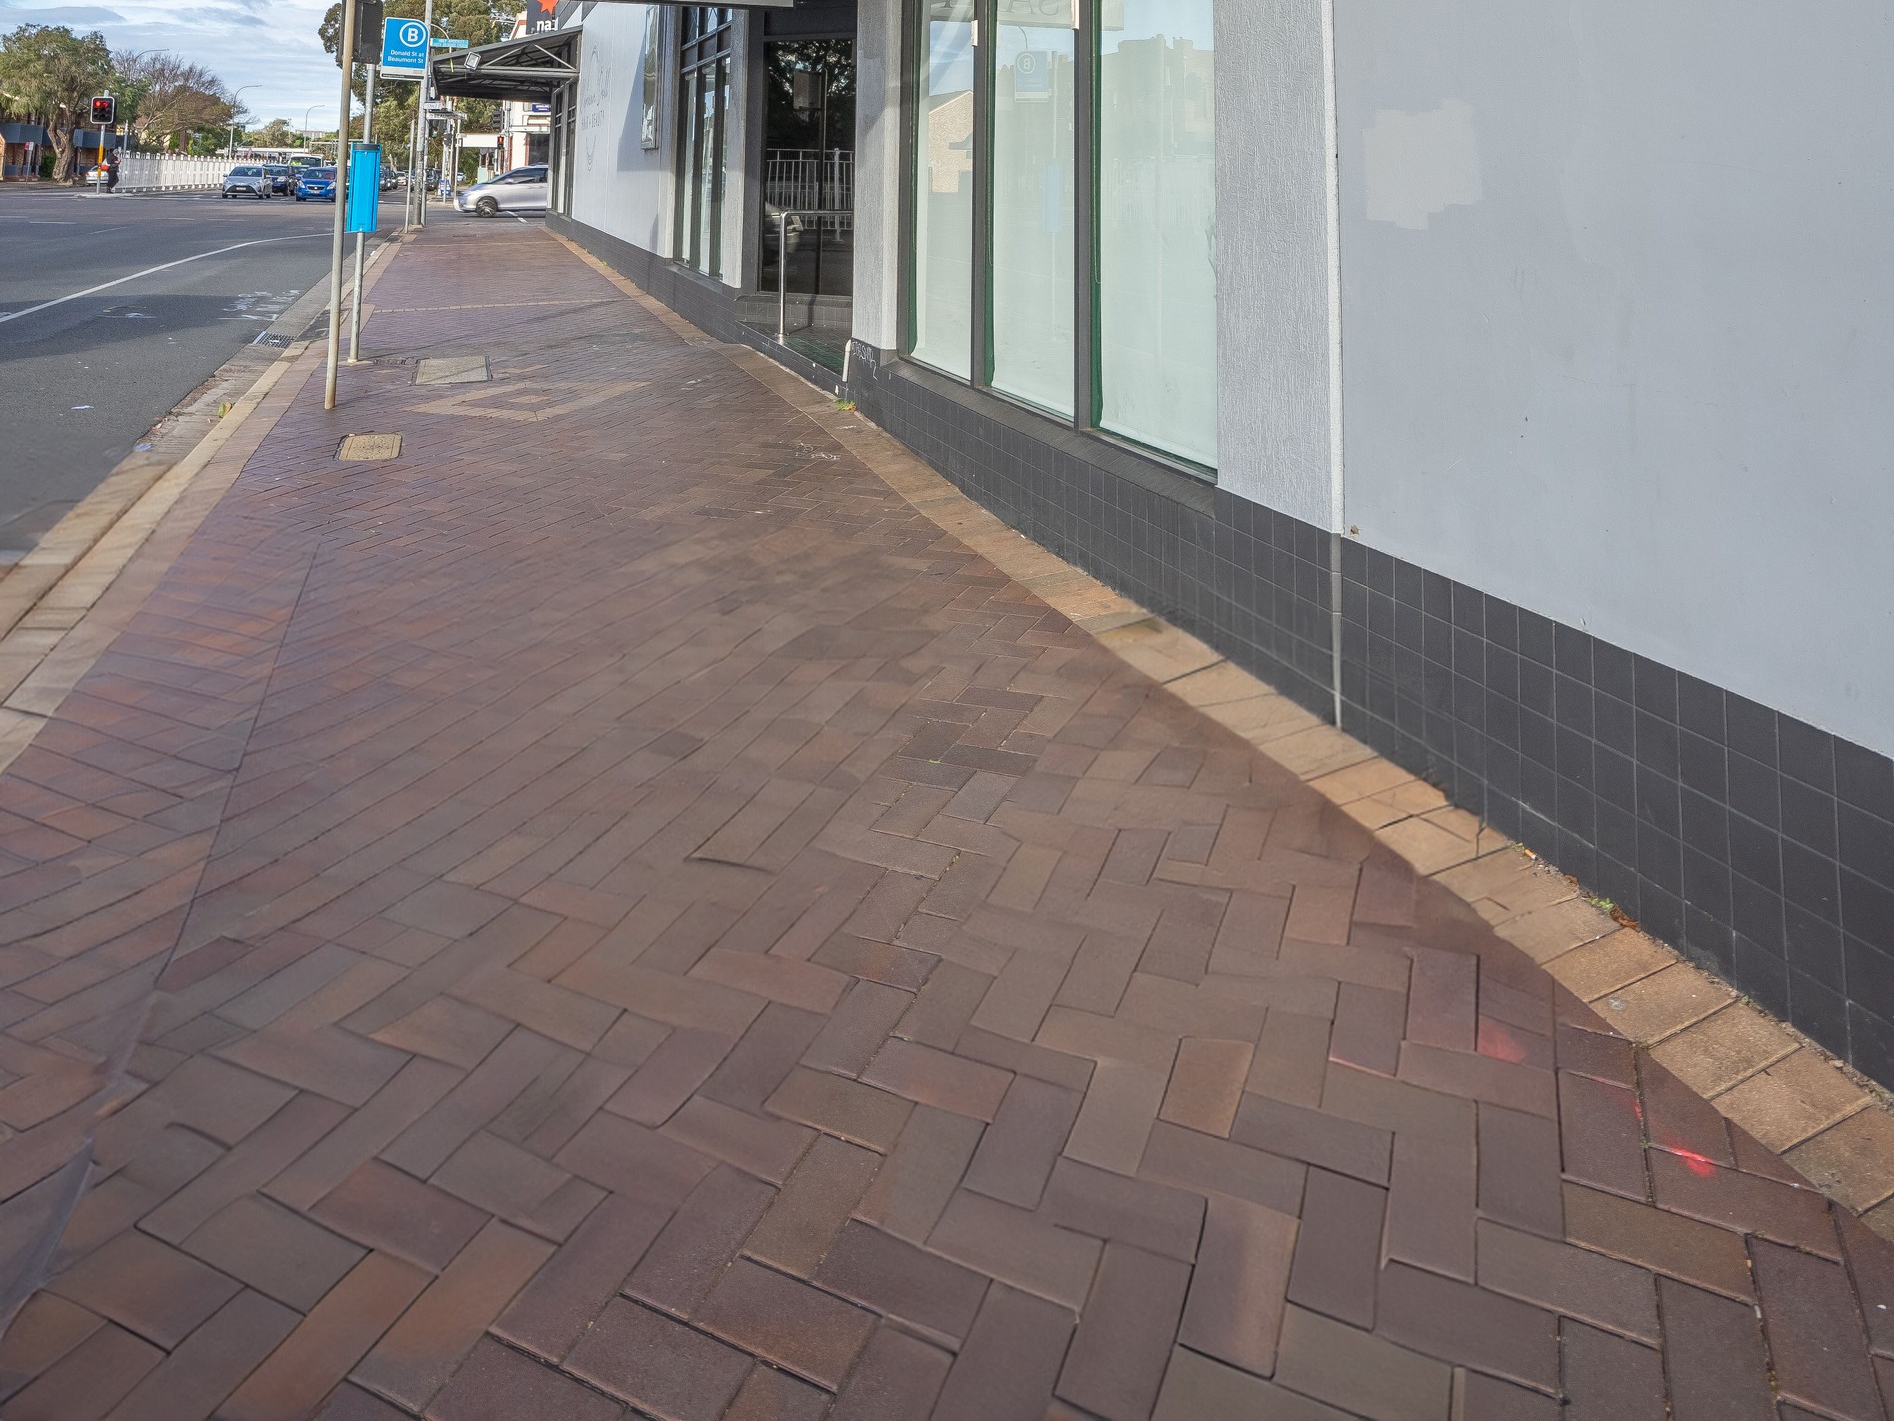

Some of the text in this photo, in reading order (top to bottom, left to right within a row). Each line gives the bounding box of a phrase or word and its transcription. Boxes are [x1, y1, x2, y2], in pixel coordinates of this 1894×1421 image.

[408, 28, 418, 41] B
[390, 49, 411, 57] Donald
[387, 55, 417, 63] Beaumont
